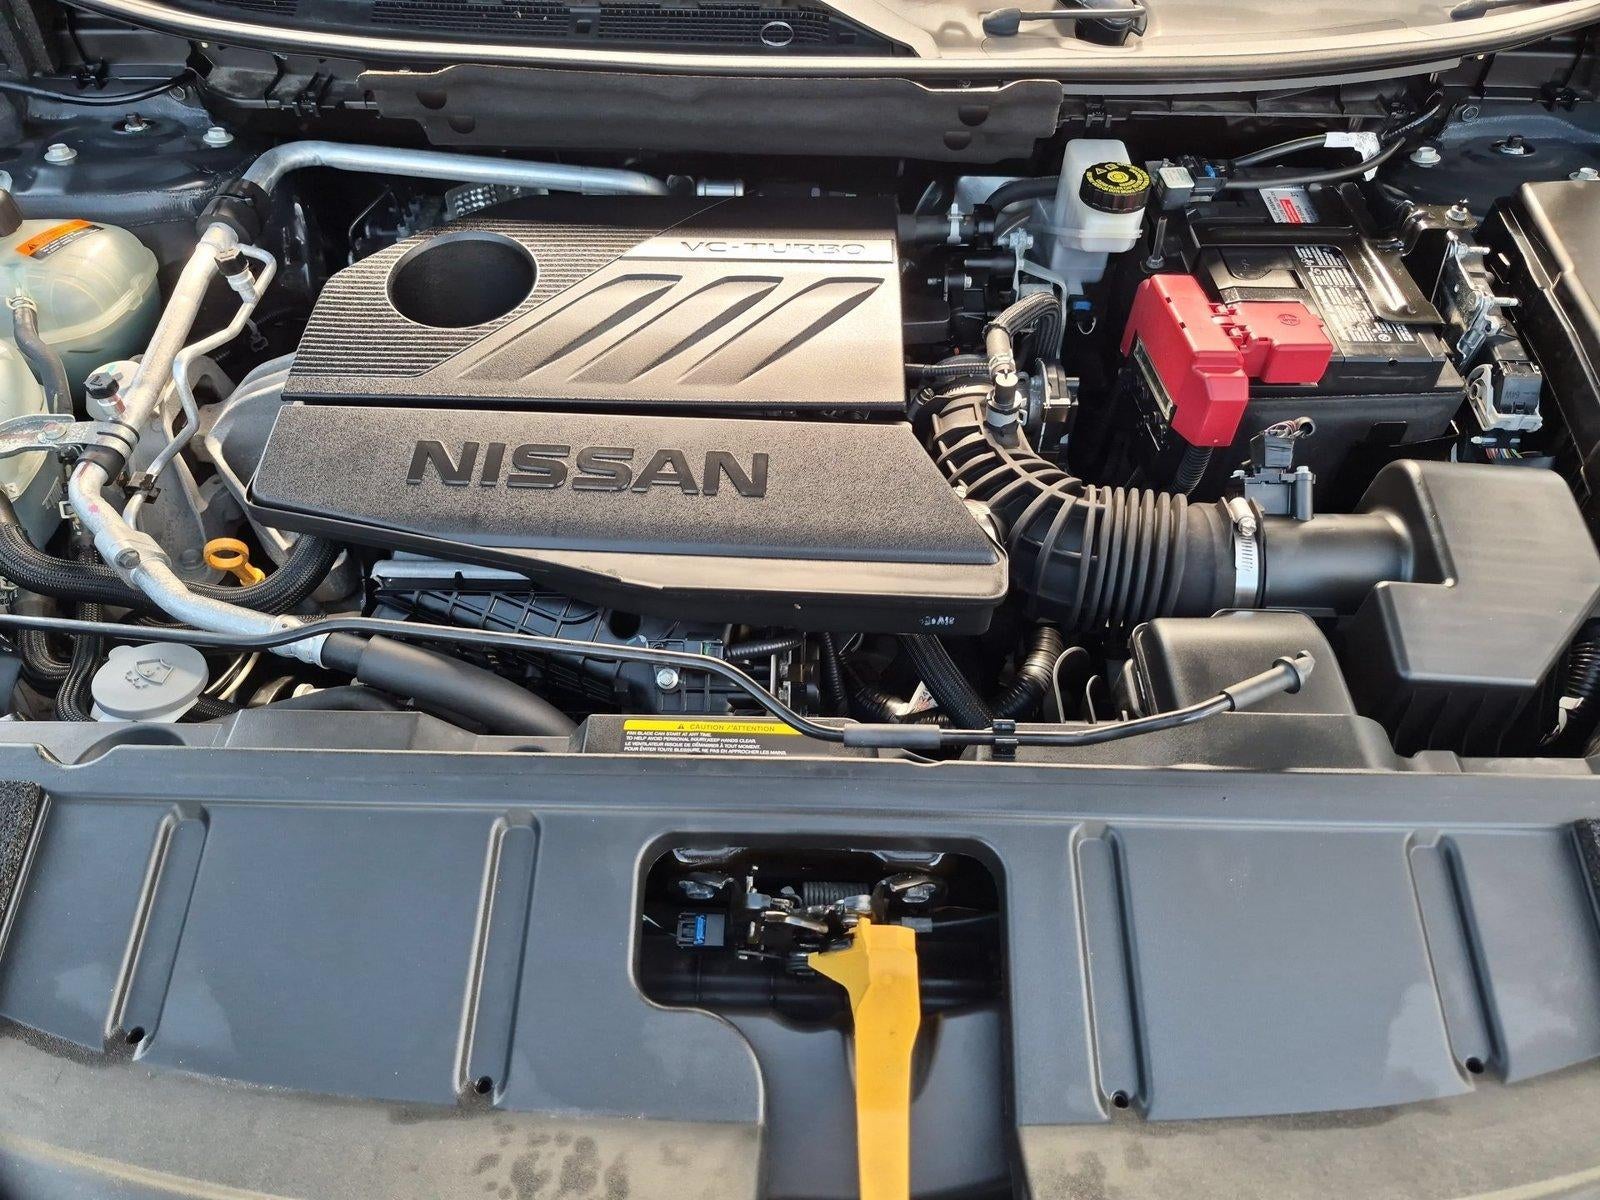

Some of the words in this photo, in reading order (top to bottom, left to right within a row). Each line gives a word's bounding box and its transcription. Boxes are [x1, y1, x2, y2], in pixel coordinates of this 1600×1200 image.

[680, 241, 866, 255] VC-TURBO
[405, 440, 770, 498] NISSAN
[689, 723, 725, 731] CAUTION
